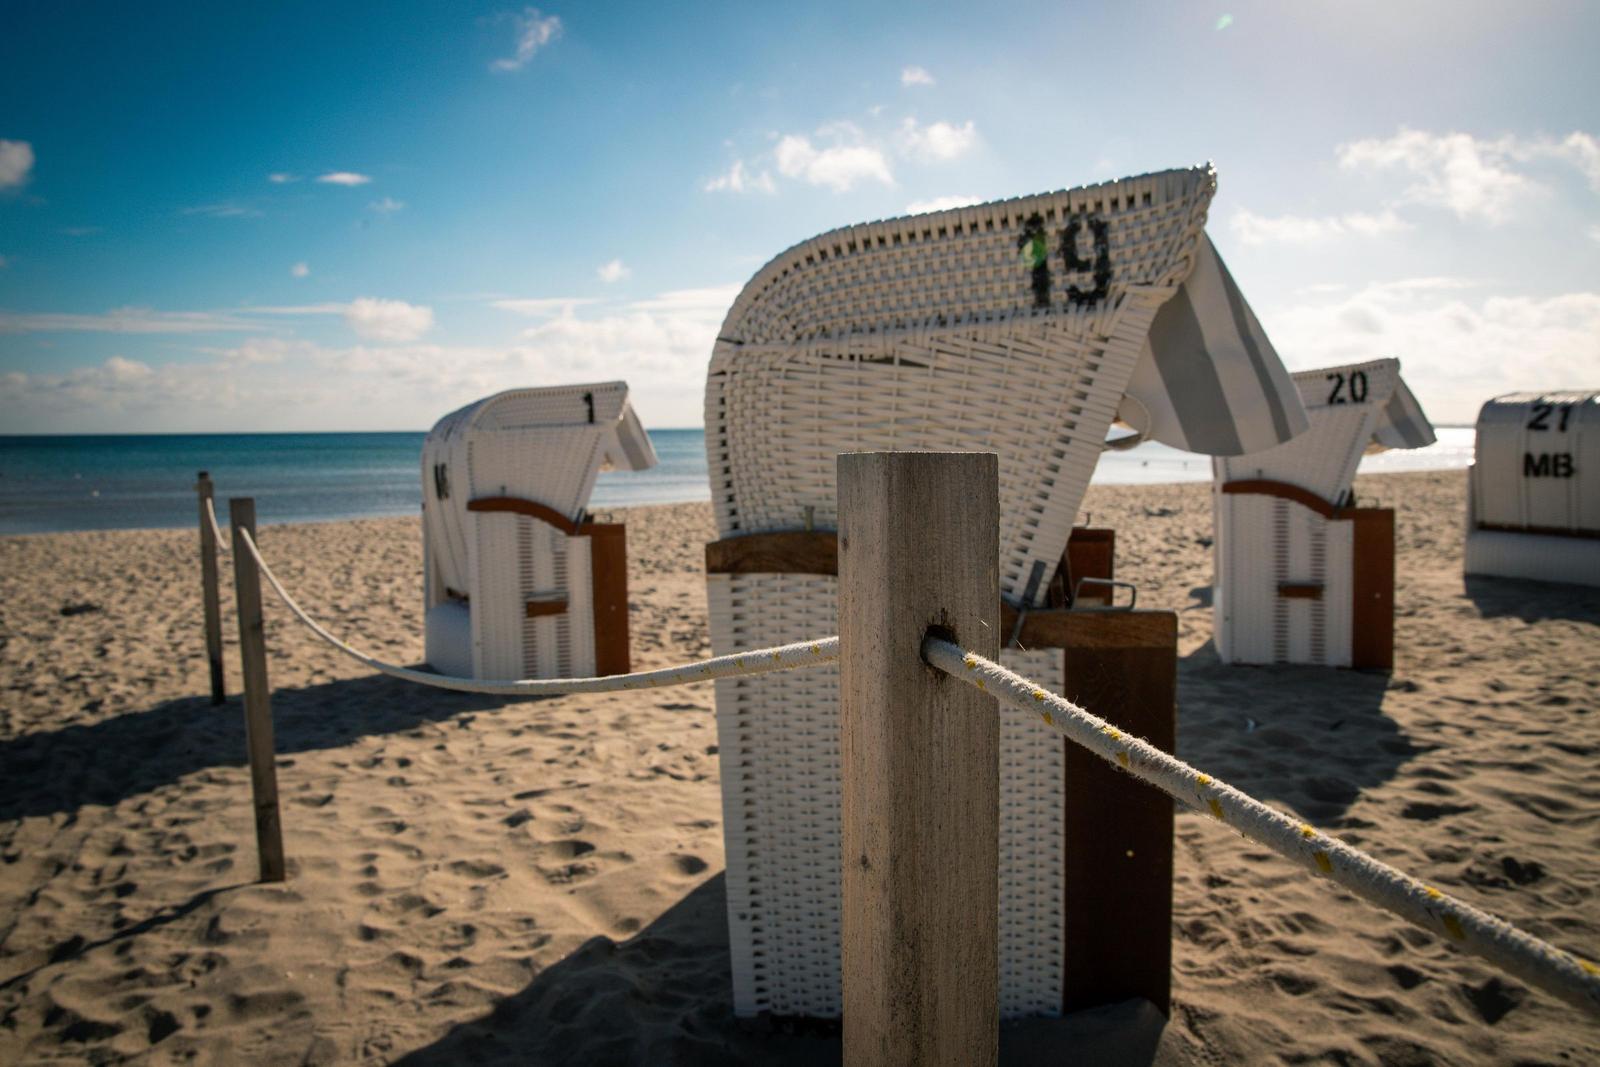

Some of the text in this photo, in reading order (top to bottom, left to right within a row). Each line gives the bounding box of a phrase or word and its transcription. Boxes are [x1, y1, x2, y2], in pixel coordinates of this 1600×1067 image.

[1012, 212, 1109, 308] 19
[1326, 370, 1368, 405] 20
[583, 391, 594, 424] 1
[1526, 403, 1573, 432] 21
[1523, 452, 1575, 478] MB
